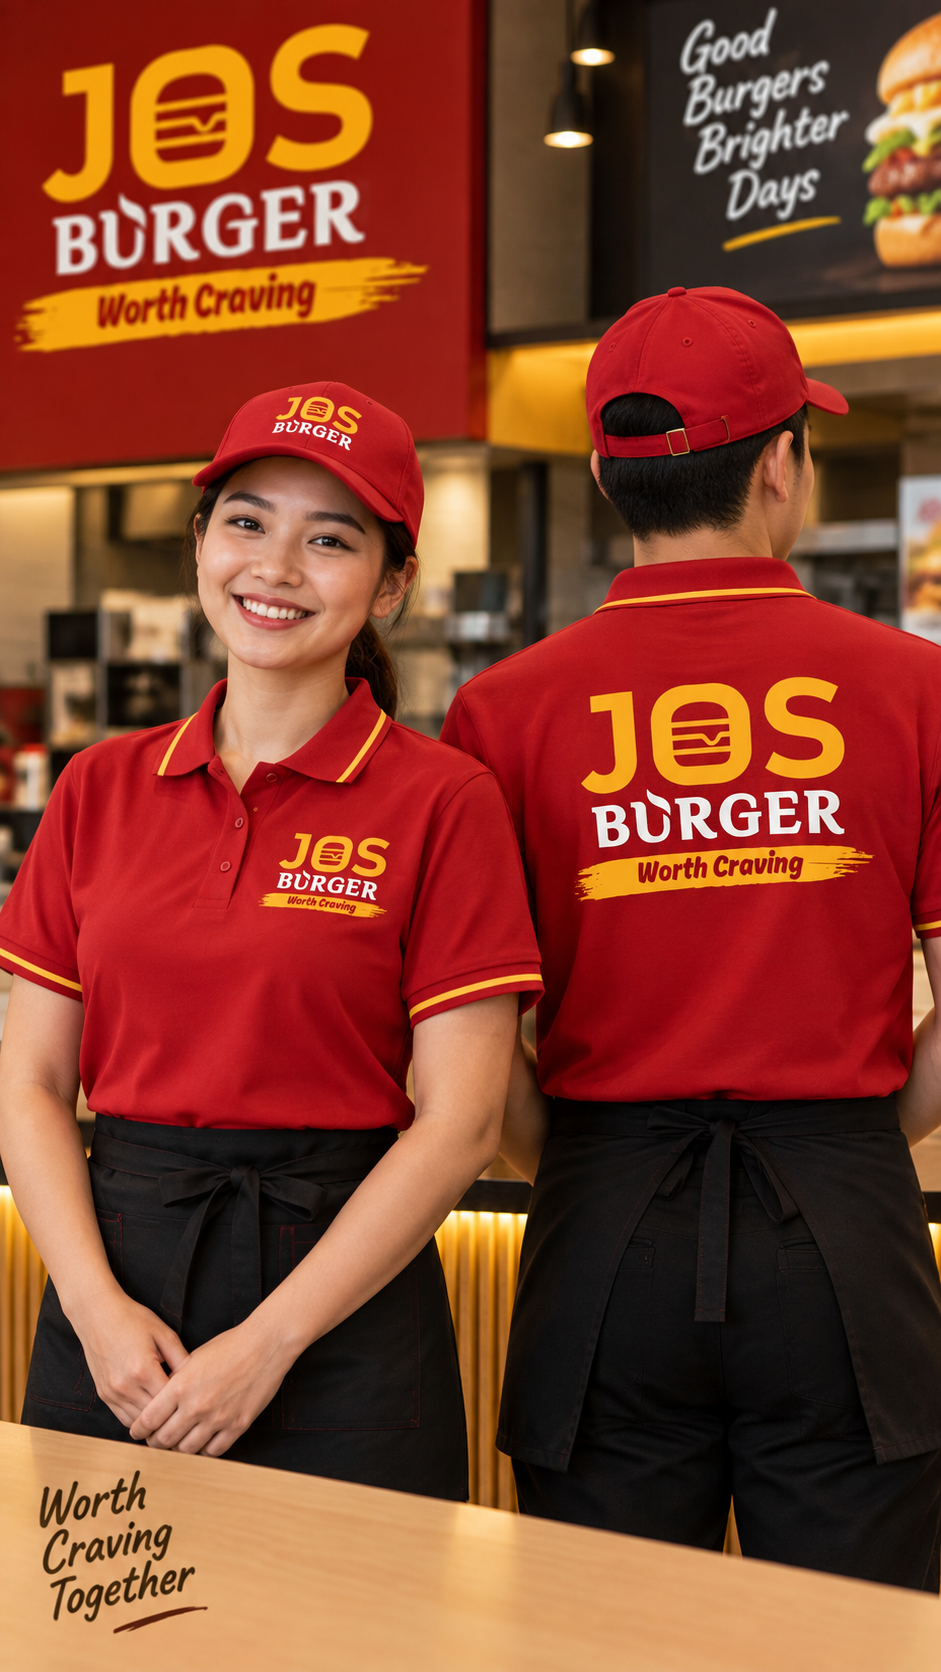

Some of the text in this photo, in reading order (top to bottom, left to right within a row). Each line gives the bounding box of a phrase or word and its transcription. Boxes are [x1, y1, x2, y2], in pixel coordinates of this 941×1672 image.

[680, 7, 777, 75] Good
[42, 24, 373, 203] JOS
[683, 60, 829, 127] Burgers
[694, 107, 849, 175] Brighter
[726, 168, 820, 221] Days
[53, 180, 365, 276] BURGER
[97, 272, 317, 329] Worth Craving
[272, 419, 352, 451] BURGER
[275, 396, 362, 435] JOS
[581, 676, 845, 794] JOS
[591, 789, 845, 848] BURGER
[279, 832, 390, 877] JOS
[638, 850, 804, 883] Worth Craving
[277, 870, 378, 901] BURGER
[287, 895, 357, 914] Worth Craving
